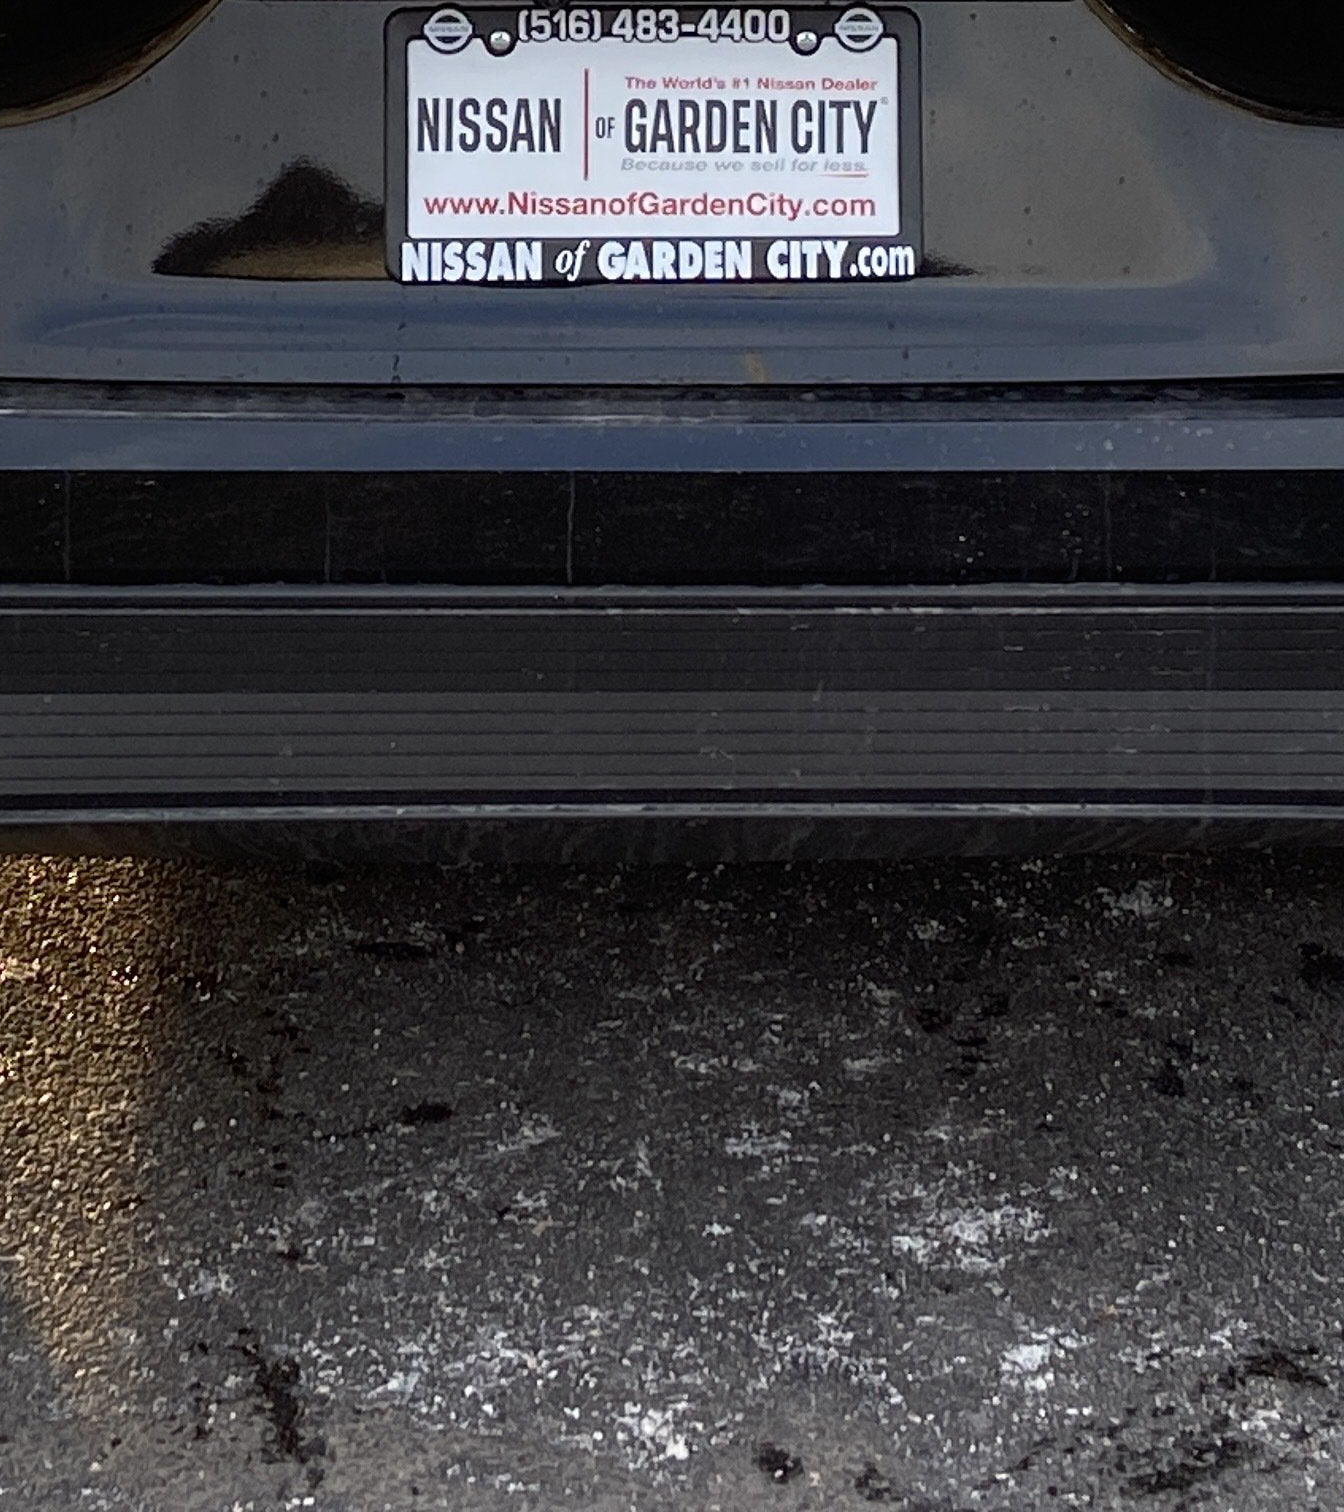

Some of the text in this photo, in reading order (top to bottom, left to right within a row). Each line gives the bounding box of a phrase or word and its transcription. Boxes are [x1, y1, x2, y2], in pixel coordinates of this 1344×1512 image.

[517, 9, 790, 43] (516) 483-4400
[624, 76, 878, 91] The World's #1 Nissan Dealer
[417, 98, 877, 155] NISSAN OF GARDEN CITY
[621, 158, 708, 172] Because
[714, 161, 744, 172] we
[750, 158, 786, 172] sell
[791, 158, 819, 172] for
[423, 191, 876, 221] www.NissanofGardenCity.com
[401, 240, 916, 281] NISSAN of GARDEN CITY.com
